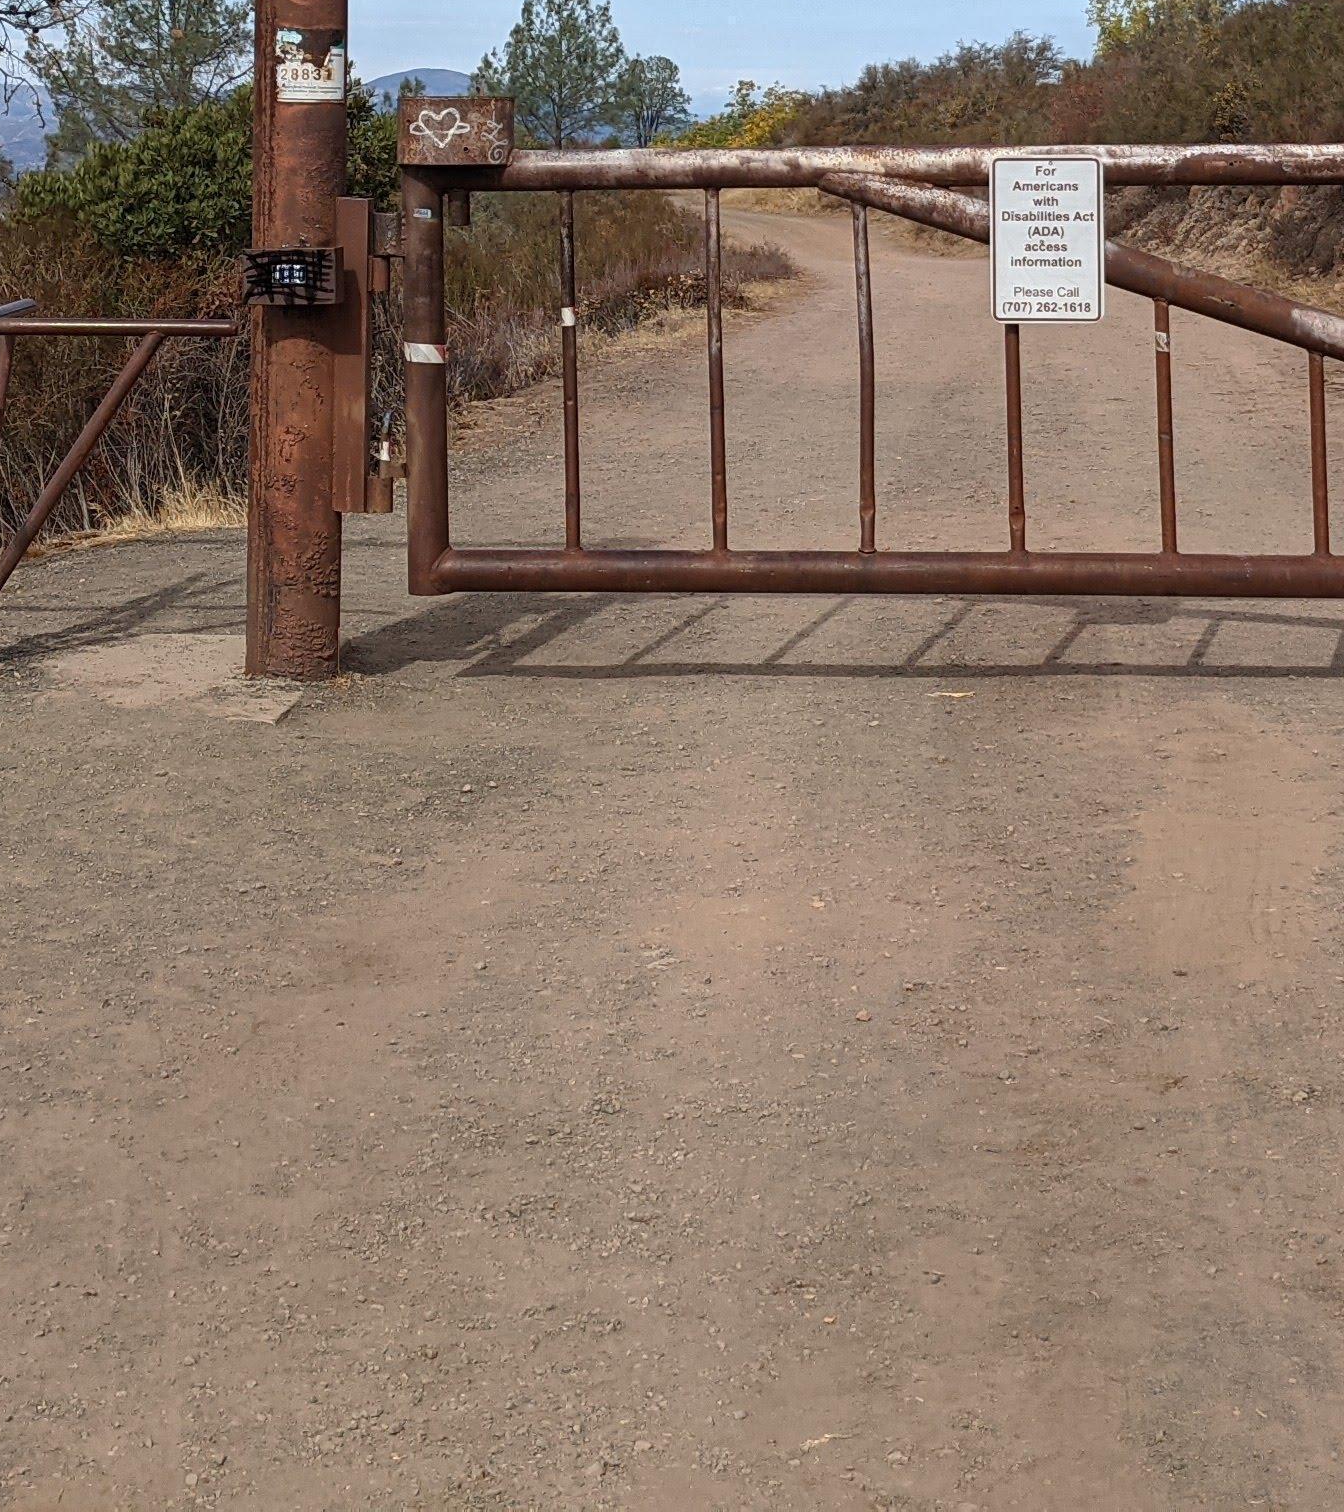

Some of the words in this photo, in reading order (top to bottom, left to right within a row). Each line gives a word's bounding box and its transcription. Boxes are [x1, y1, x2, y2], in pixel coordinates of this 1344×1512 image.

[1035, 166, 1056, 176] For
[1013, 181, 1078, 192] Americans
[1033, 197, 1058, 206] with
[1002, 211, 1069, 221] Disabilities
[1073, 212, 1094, 221] Act
[1027, 227, 1064, 238] (ADA)
[1024, 243, 1067, 252] access
[1011, 257, 1081, 267] information
[1013, 287, 1053, 297] Please
[1057, 287, 1080, 297] Call
[1003, 303, 1032, 314] (707)
[1036, 302, 1091, 313] 262-1618
